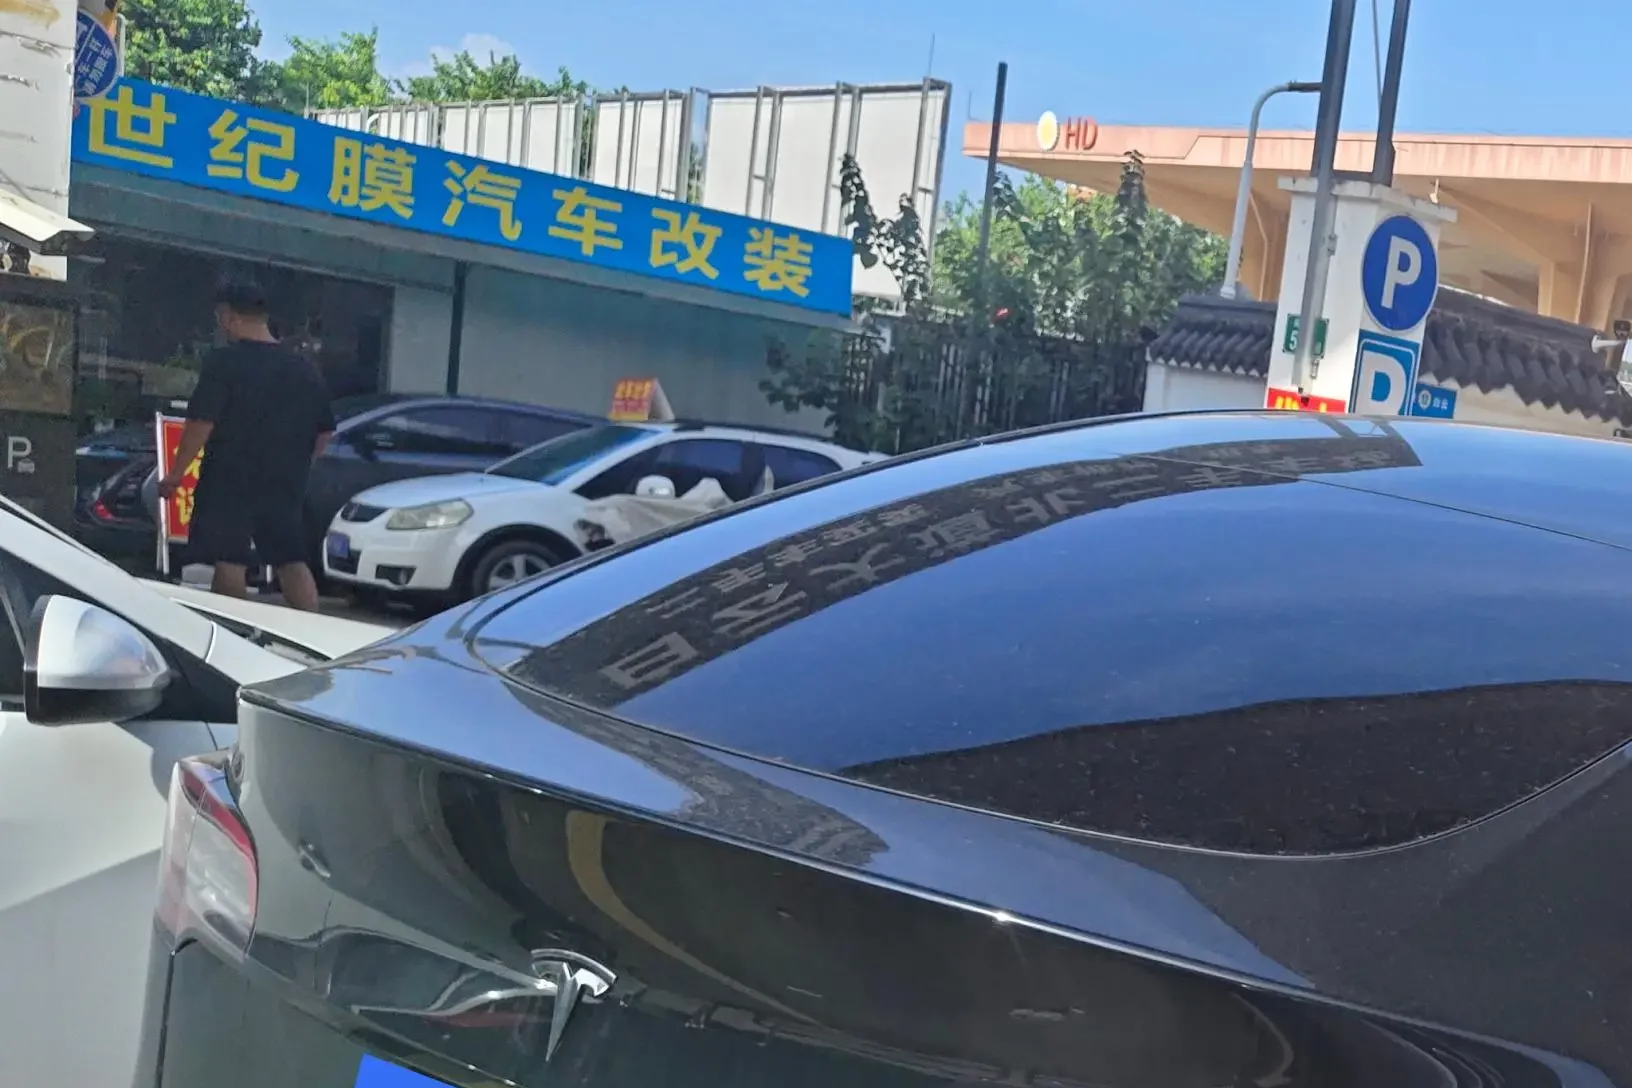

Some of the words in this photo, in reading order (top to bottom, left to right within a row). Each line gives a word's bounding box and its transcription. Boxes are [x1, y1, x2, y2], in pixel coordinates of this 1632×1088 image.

[1064, 116, 1098, 150] HD
[87, 88, 815, 298] 世纪膜汽车改装
[1380, 235, 1422, 309] P
[7, 436, 32, 468] P
